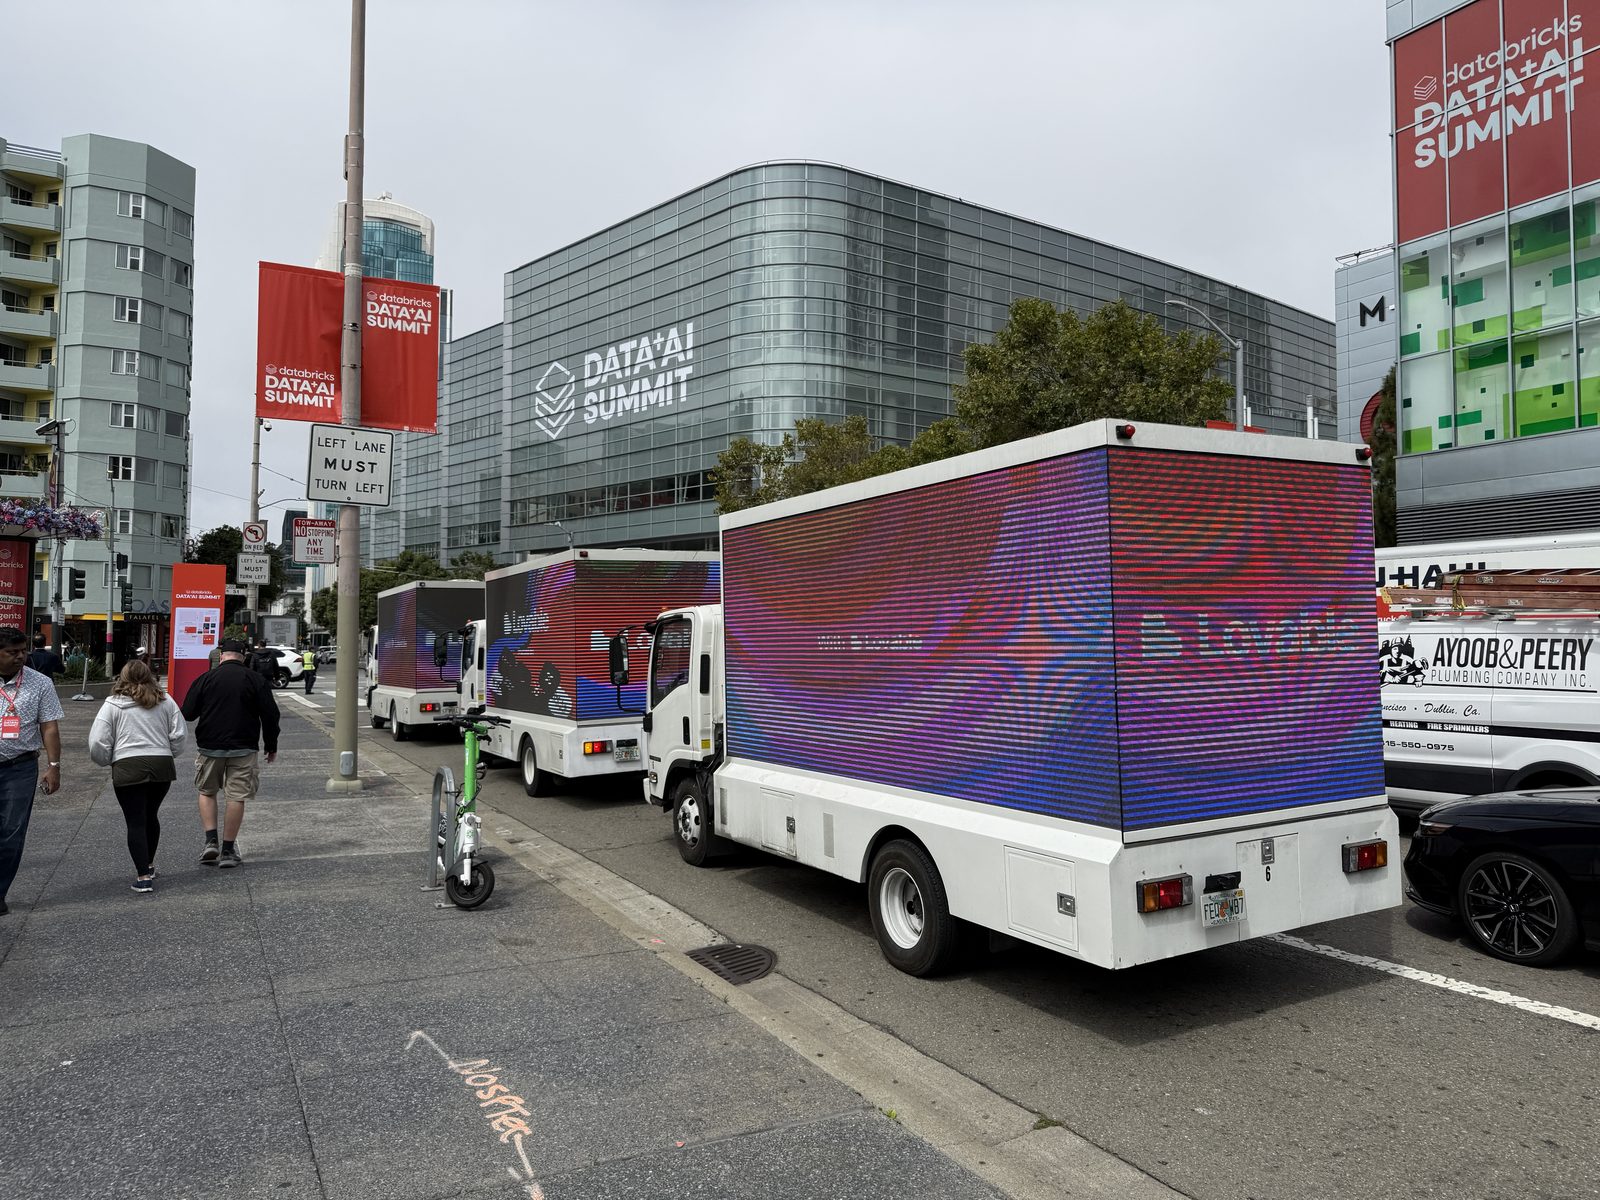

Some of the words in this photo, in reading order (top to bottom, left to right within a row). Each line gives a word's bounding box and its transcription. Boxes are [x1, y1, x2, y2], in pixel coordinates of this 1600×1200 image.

[1443, 14, 1582, 87] databricks
[1414, 37, 1584, 138] DATA+AI
[1414, 76, 1584, 168] SUMMIT
[379, 293, 432, 308] databricks
[367, 302, 432, 322] DATA+AI
[1360, 296, 1385, 327] M
[367, 315, 431, 335] SUMMIT
[584, 322, 694, 388] DATA+AI
[279, 366, 334, 381] databricks
[265, 375, 334, 395] DATA+AI
[584, 365, 692, 424] SUMMIT
[265, 390, 334, 408] SUMMIT
[318, 437, 346, 448] LEFT
[355, 441, 386, 453] LANE
[324, 458, 377, 474] MUST
[315, 478, 346, 491] TURN
[356, 482, 384, 494] LEFT
[295, 526, 306, 536] NO
[308, 528, 334, 537] STOPPING
[1198, 608, 1360, 656] Lovable
[1432, 637, 1594, 670] AYOOB&PEERY
[1431, 669, 1490, 684] PLUMBING
[1498, 671, 1557, 687] COMPANY
[1564, 674, 1592, 688] INC.
[1463, 704, 1481, 717] Ca.
[1427, 722, 1443, 730] FIRE
[1444, 724, 1490, 733] SPRINKLERS
[1383, 740, 1454, 751] 15-550-0975
[1266, 866, 1271, 881] 6
